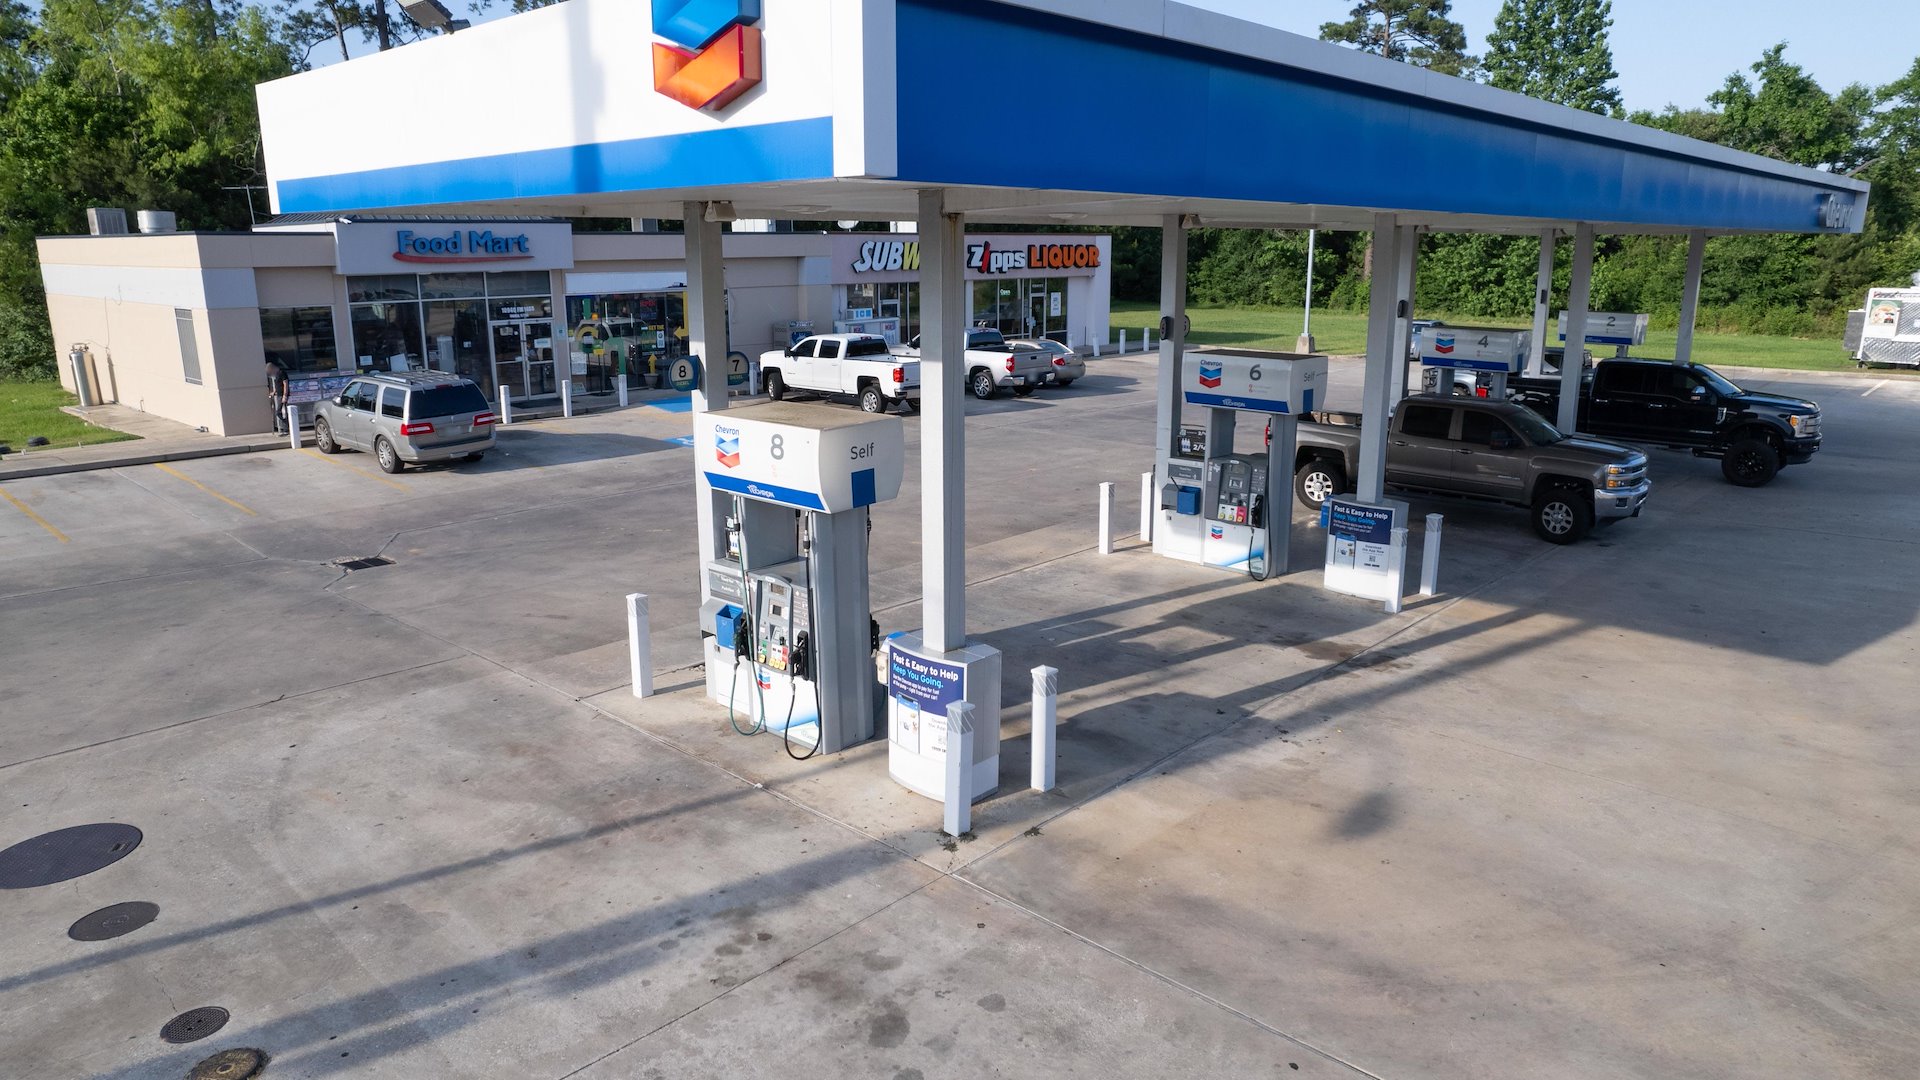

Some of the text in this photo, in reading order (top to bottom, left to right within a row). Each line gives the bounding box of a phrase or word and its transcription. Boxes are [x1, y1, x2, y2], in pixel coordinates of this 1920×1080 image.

[397, 230, 529, 254] Food Mart
[968, 240, 1100, 274] Zipps LIQUOR
[1606, 316, 1616, 326] 2
[1478, 335, 1488, 348] 4
[679, 366, 686, 378] 8
[732, 360, 739, 372] 7
[1250, 364, 1262, 381] 6
[1304, 372, 1315, 382] Self
[715, 424, 739, 436] Chevron
[771, 434, 784, 460] 8
[850, 442, 874, 460] Self
[1351, 509, 1365, 517] Easy
[893, 652, 958, 682] Fast & Easy to Help
[893, 663, 944, 689] Keep You Going.
